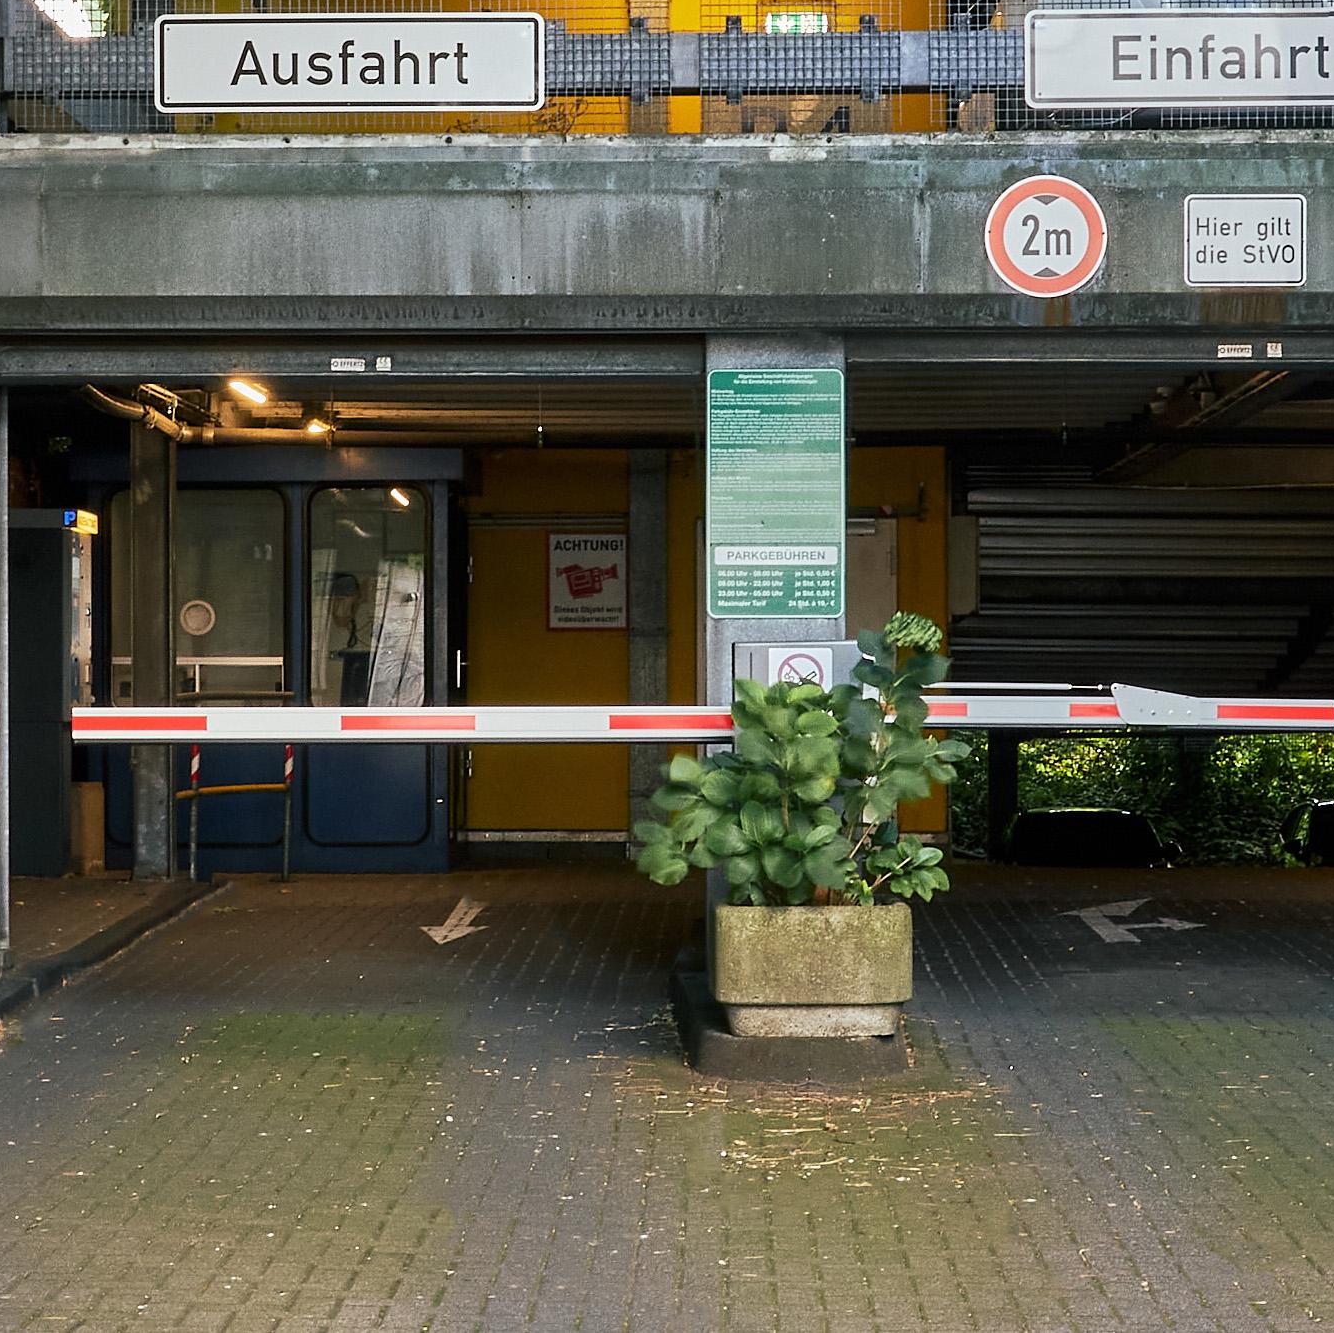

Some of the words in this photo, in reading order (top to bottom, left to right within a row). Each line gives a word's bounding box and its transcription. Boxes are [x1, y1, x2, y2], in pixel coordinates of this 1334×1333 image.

[230, 39, 469, 86] Ausfahrt
[1112, 33, 1330, 81] Einfahrt
[1196, 217, 1243, 236] Hier
[1257, 217, 1291, 241] gilt
[1196, 245, 1228, 264] die
[1243, 245, 1295, 264] StVO
[63, 510, 77, 526] P
[553, 539, 624, 552] ACHTUNG!
[726, 549, 826, 561] PARKGEBÜHREN
